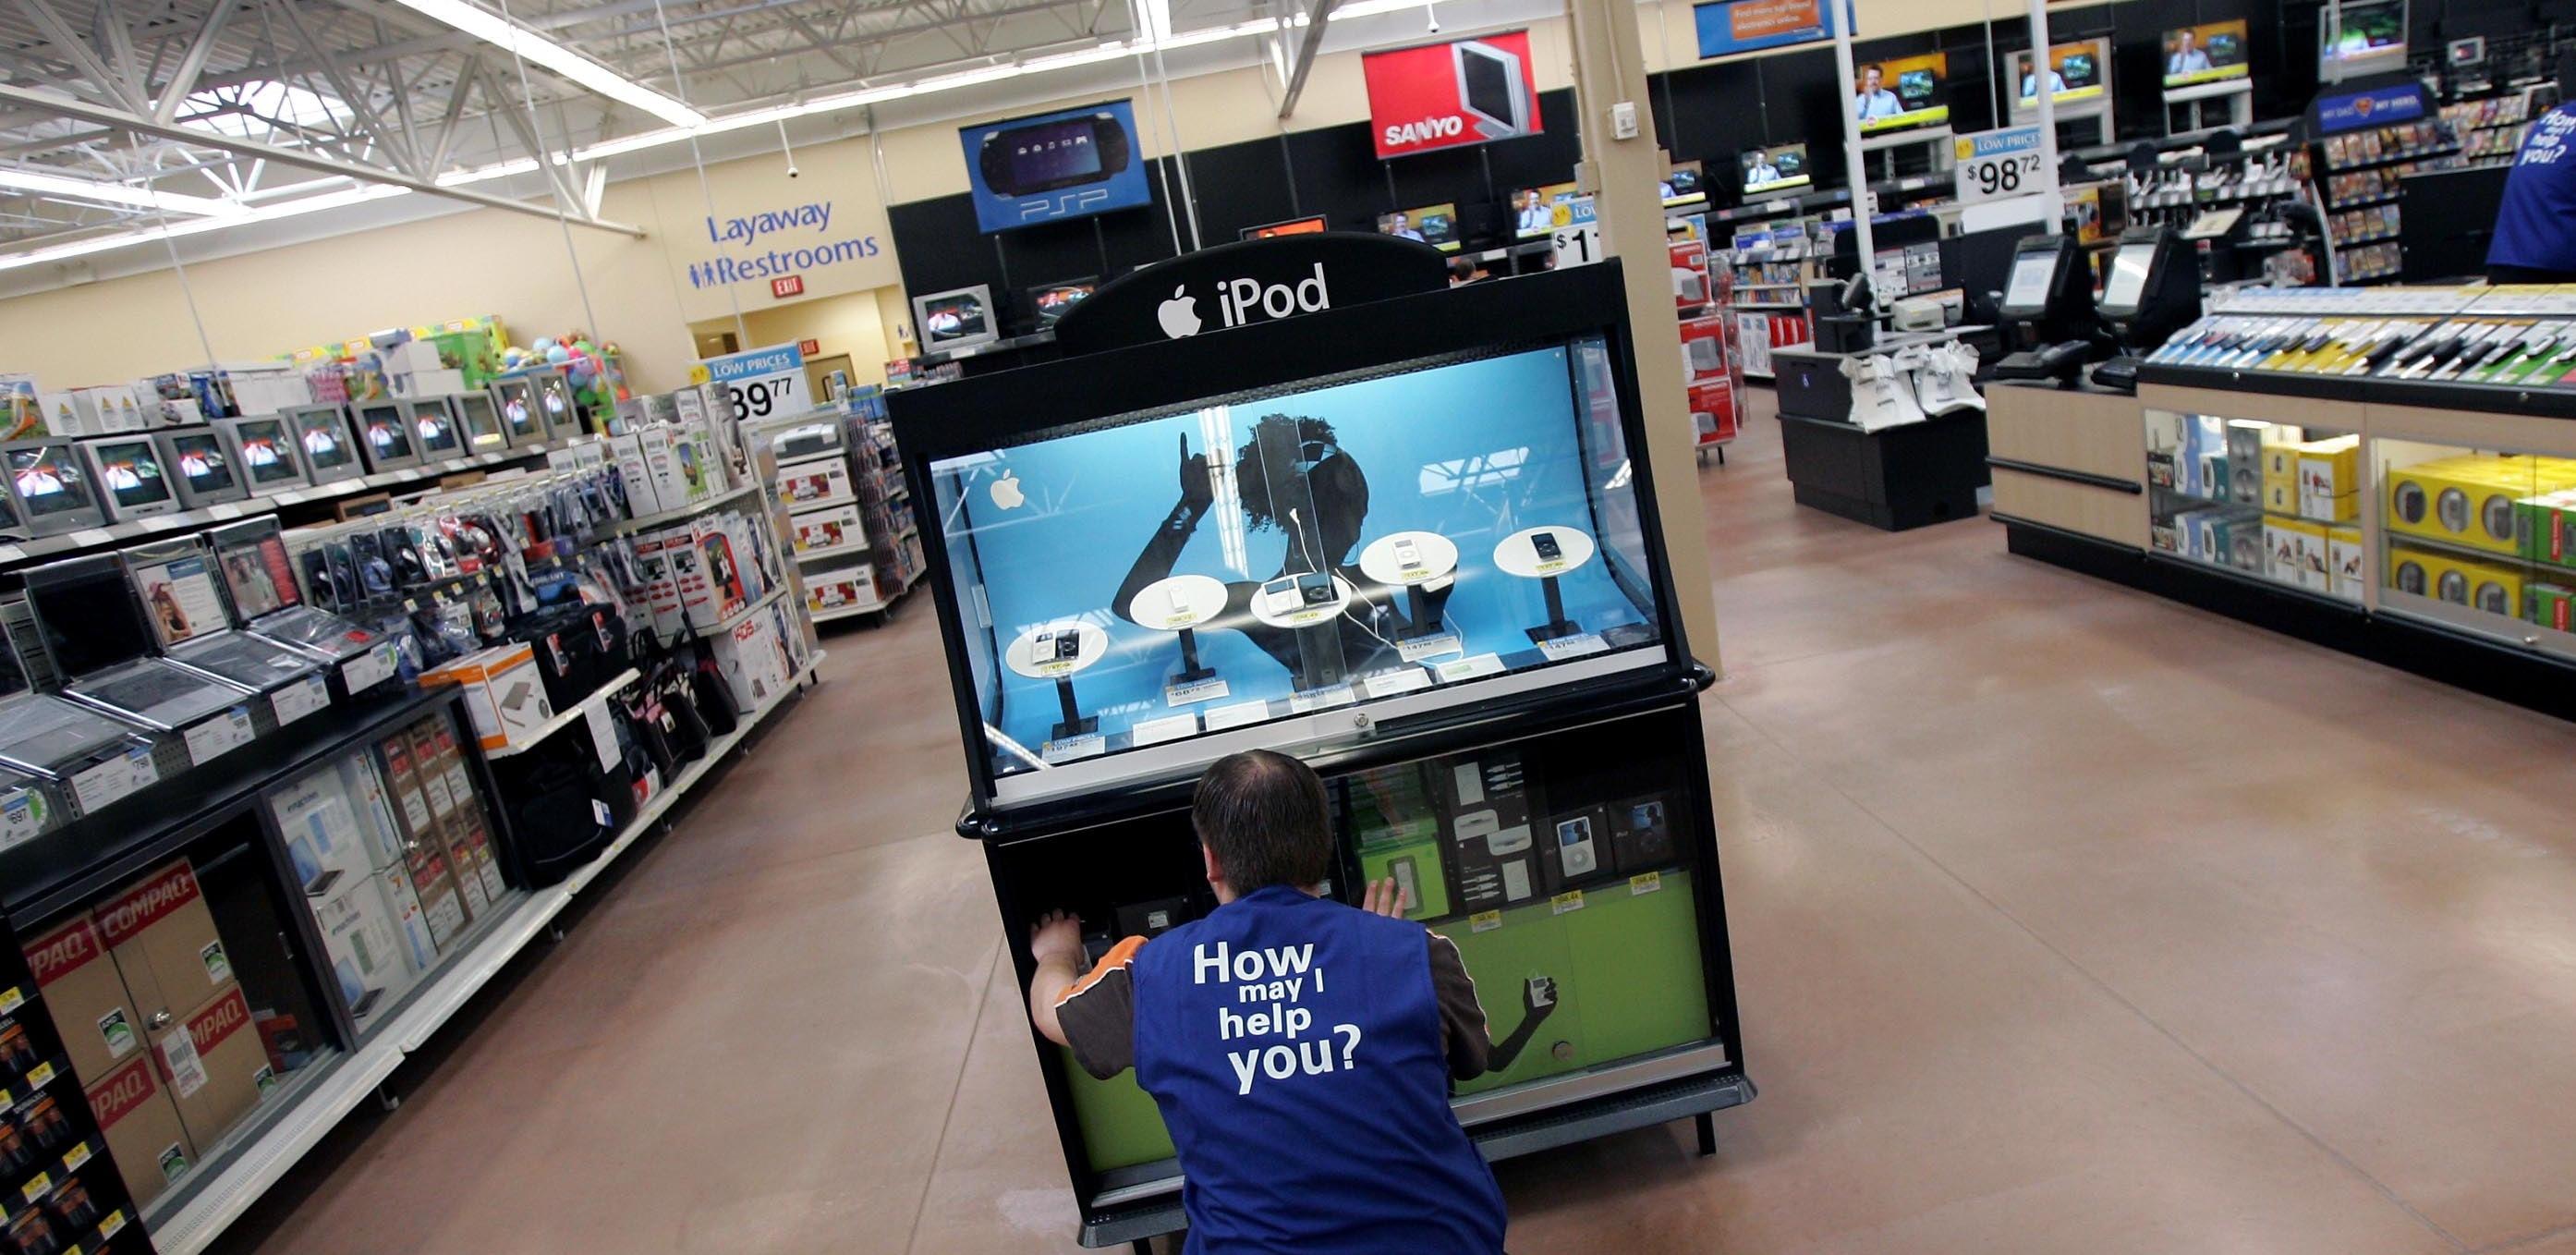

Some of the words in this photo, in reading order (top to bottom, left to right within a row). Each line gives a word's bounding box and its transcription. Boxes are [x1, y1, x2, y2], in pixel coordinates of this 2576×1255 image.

[1386, 116, 1464, 145] SANYO
[1978, 137, 2004, 152] LOW
[2530, 132, 2560, 148] help
[2519, 144, 2567, 165] you?
[1019, 188, 1109, 221] PSP
[707, 201, 832, 246] Layaway
[716, 236, 880, 285] Restrooms
[775, 276, 799, 295] EXIT
[1216, 262, 1331, 328] iPod
[713, 362, 745, 378] LOW
[747, 352, 791, 371] PRICES
[101, 872, 192, 939] COMPAQ
[1194, 941, 1315, 984] How
[1239, 977, 1284, 1003] may
[1314, 968, 1324, 993] I
[1219, 1002, 1312, 1041] help
[1227, 1023, 1362, 1095] you?
